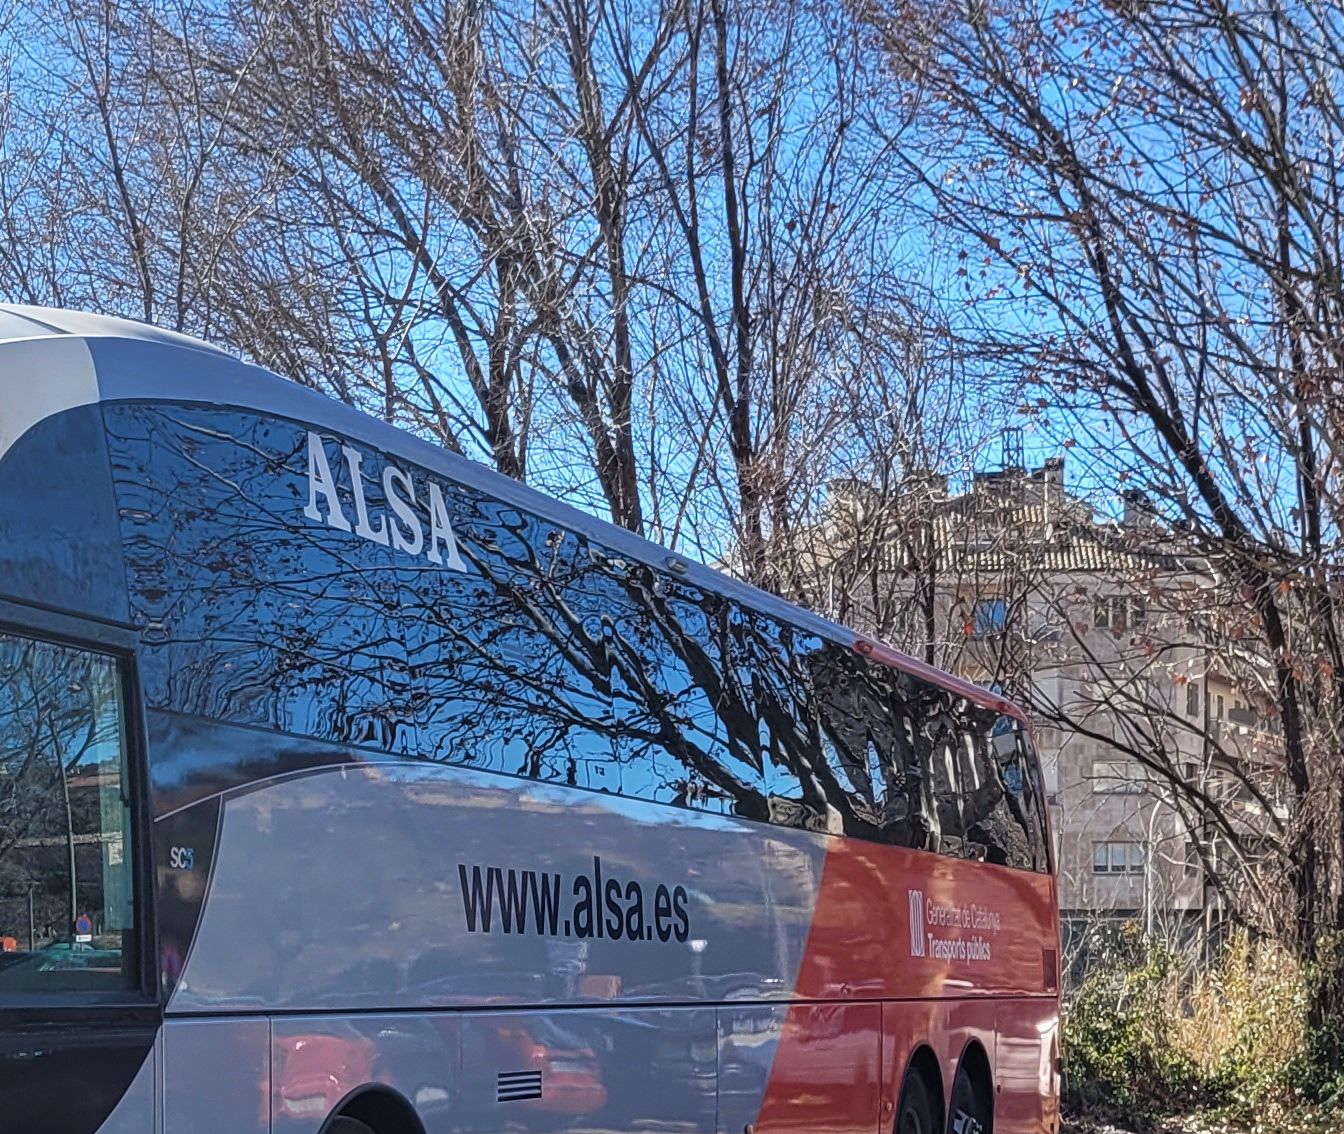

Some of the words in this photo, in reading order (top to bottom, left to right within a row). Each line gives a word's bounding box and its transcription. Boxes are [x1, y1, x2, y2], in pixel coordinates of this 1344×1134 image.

[303, 431, 468, 573] ALSA
[458, 856, 689, 943] www.alsa.es
[926, 898, 961, 928] Generalitat
[962, 904, 971, 928] de
[971, 904, 1000, 935] Catalunya
[928, 933, 965, 964] Transports
[967, 935, 991, 966] públics
